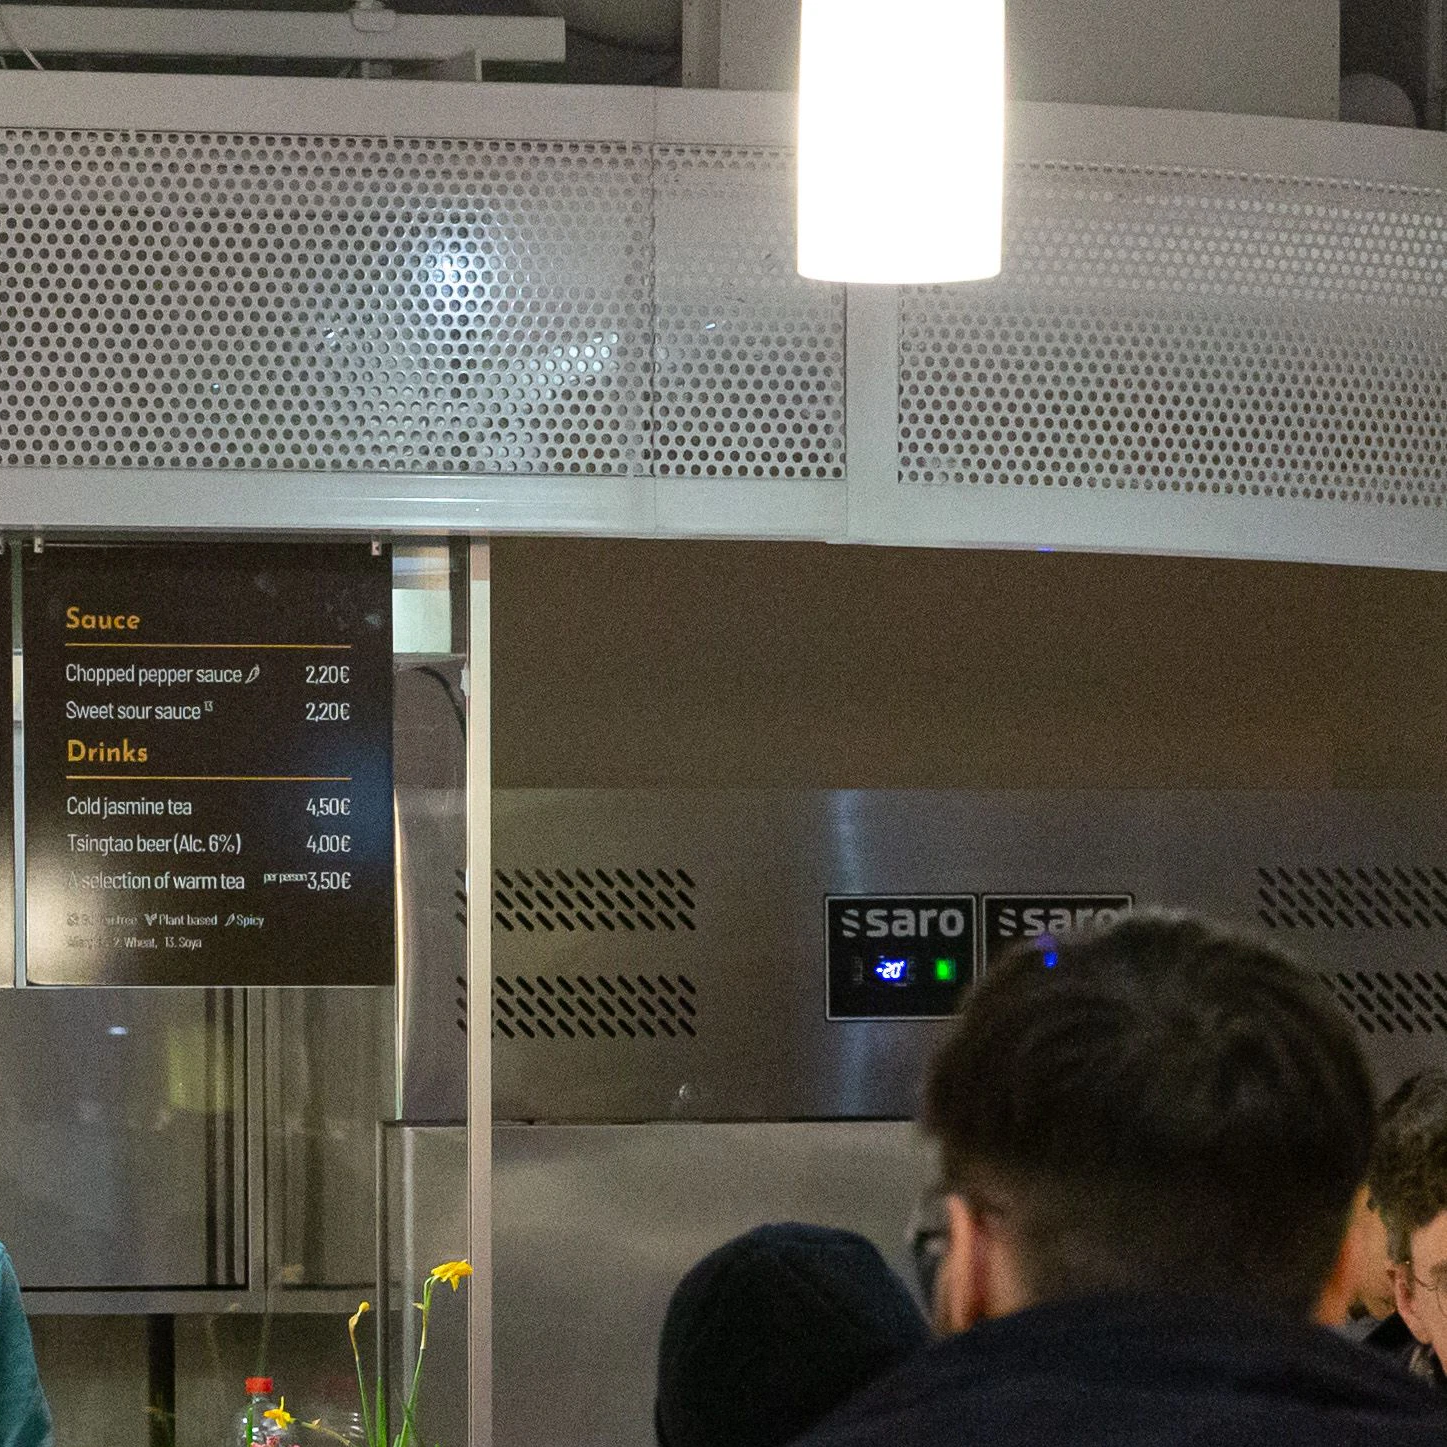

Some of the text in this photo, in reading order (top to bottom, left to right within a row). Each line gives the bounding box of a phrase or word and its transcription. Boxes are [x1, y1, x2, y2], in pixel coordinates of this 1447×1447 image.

[67, 606, 140, 629] Sauce
[67, 663, 350, 687] Chopped pepper sauce 2,20€
[67, 700, 350, 722] Sweet sour sauce 2,20€
[67, 738, 148, 762] Drinks
[67, 796, 350, 819] Cold jasmine tea 4,50€
[68, 833, 133, 856] Tsingtao
[209, 833, 242, 852] 6%)
[307, 834, 351, 854] 4,00€
[155, 871, 170, 889] of
[173, 875, 217, 889] warm
[220, 873, 245, 889] tea
[307, 871, 351, 892] 3,50€
[159, 913, 264, 928] Plant based Spicy
[866, 908, 965, 937] saro
[178, 936, 202, 949] Soya
